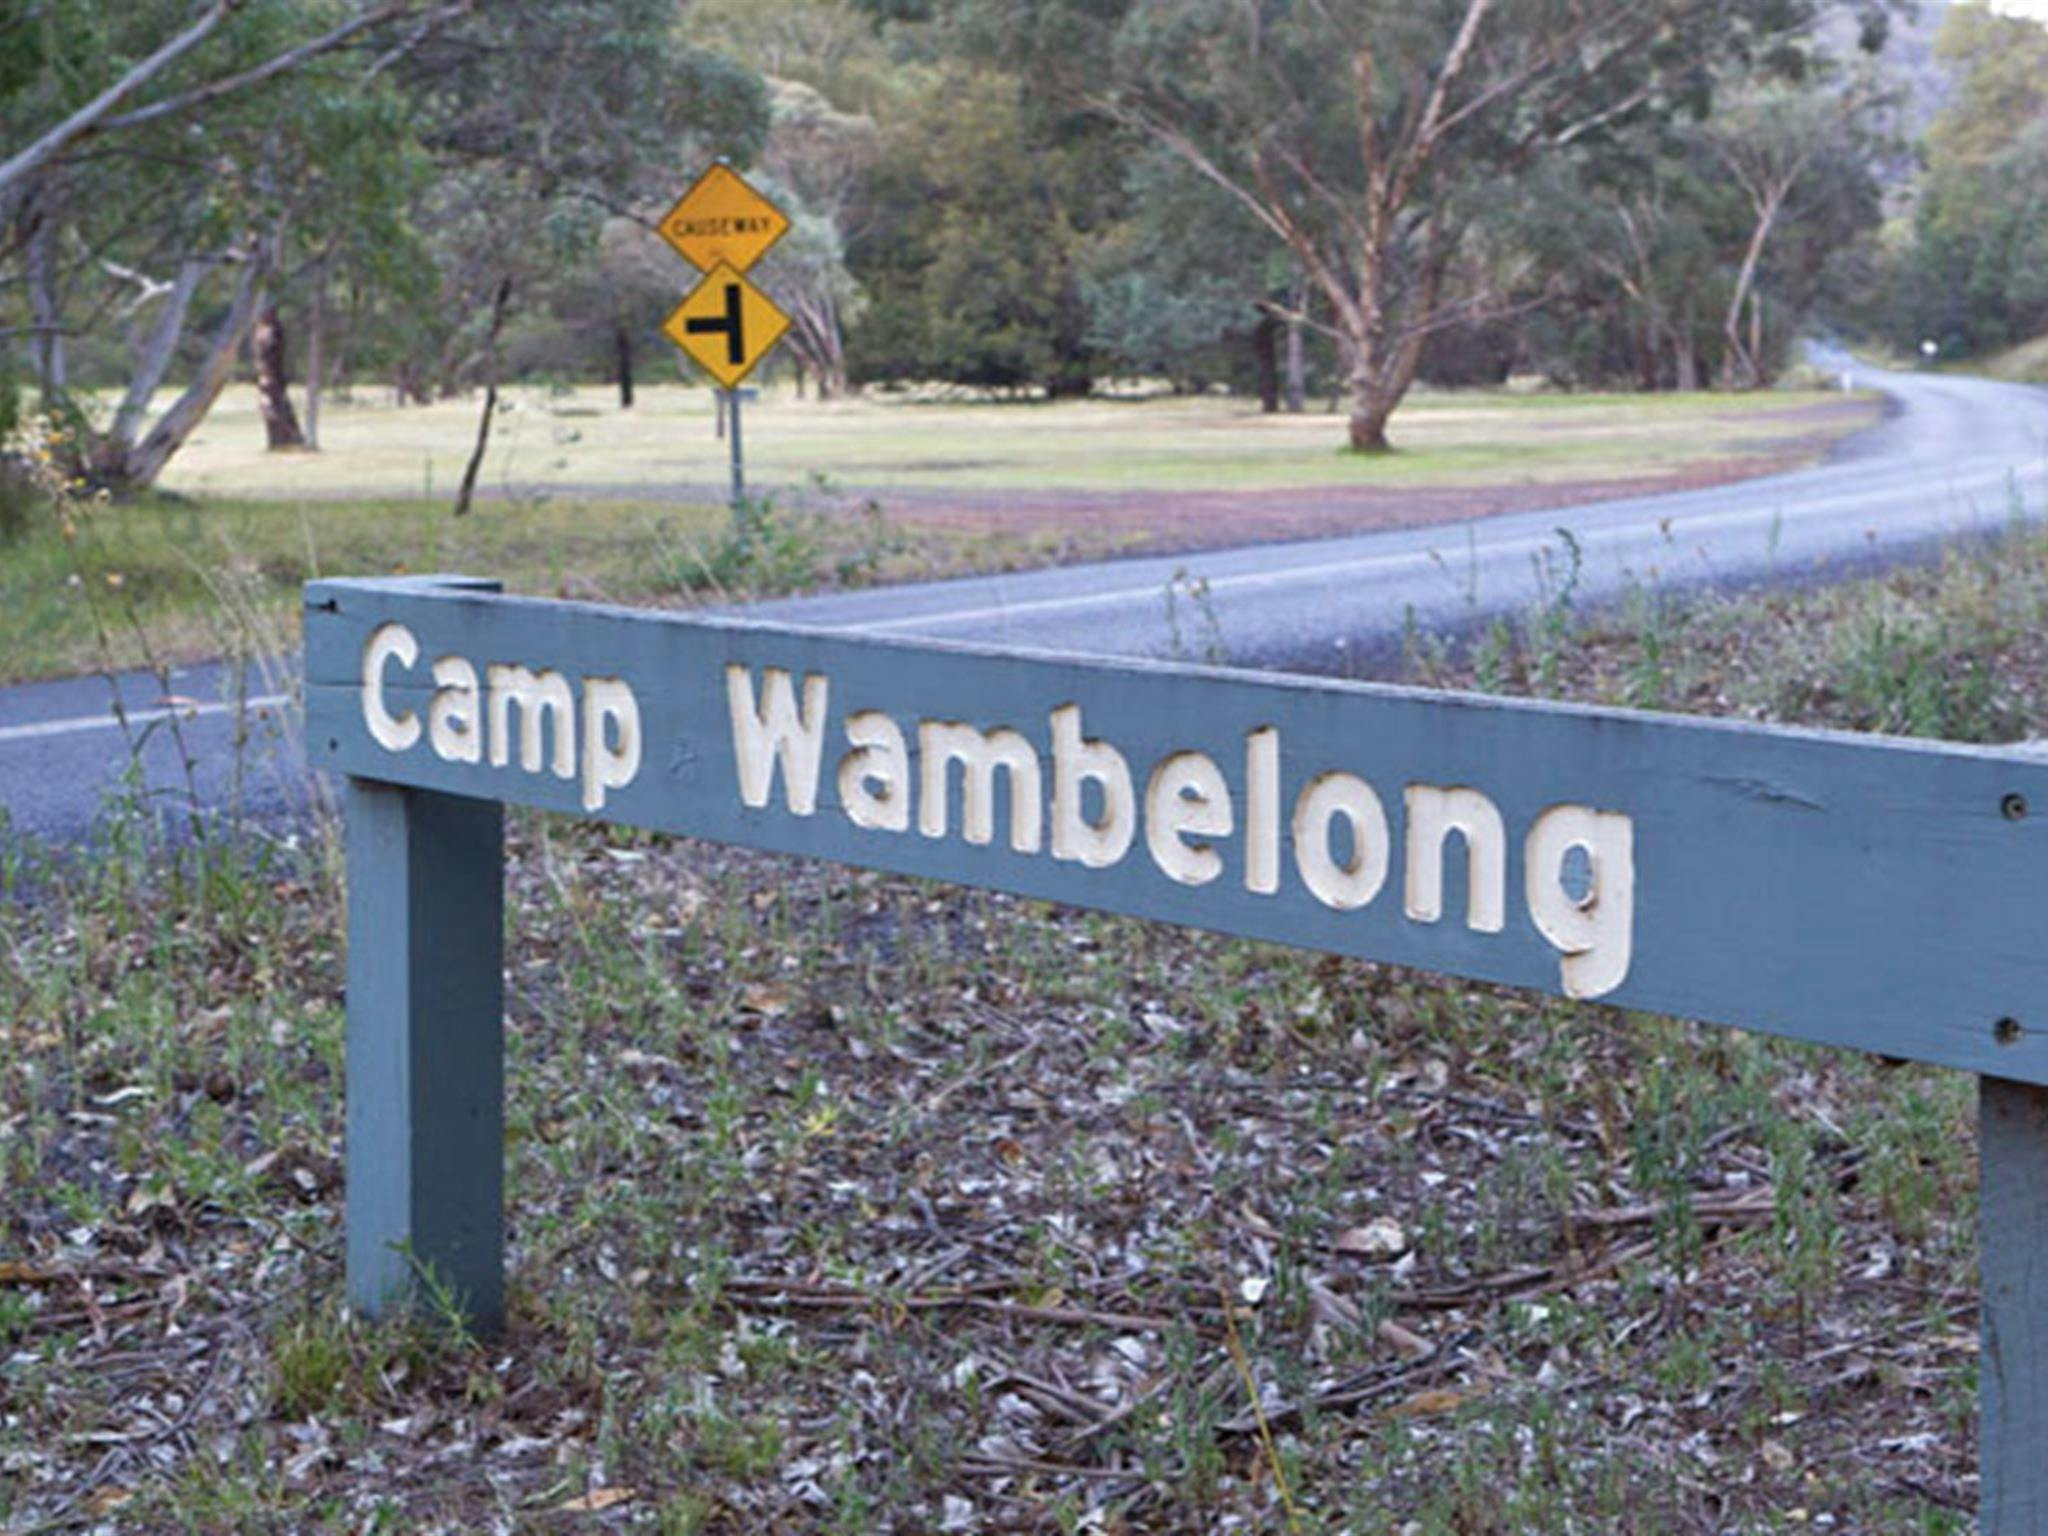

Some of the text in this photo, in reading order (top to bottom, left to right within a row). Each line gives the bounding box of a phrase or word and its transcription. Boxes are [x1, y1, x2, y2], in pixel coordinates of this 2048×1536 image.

[673, 215, 771, 236] CAUSEWAY
[361, 619, 1635, 1000] Camp Wambelong
